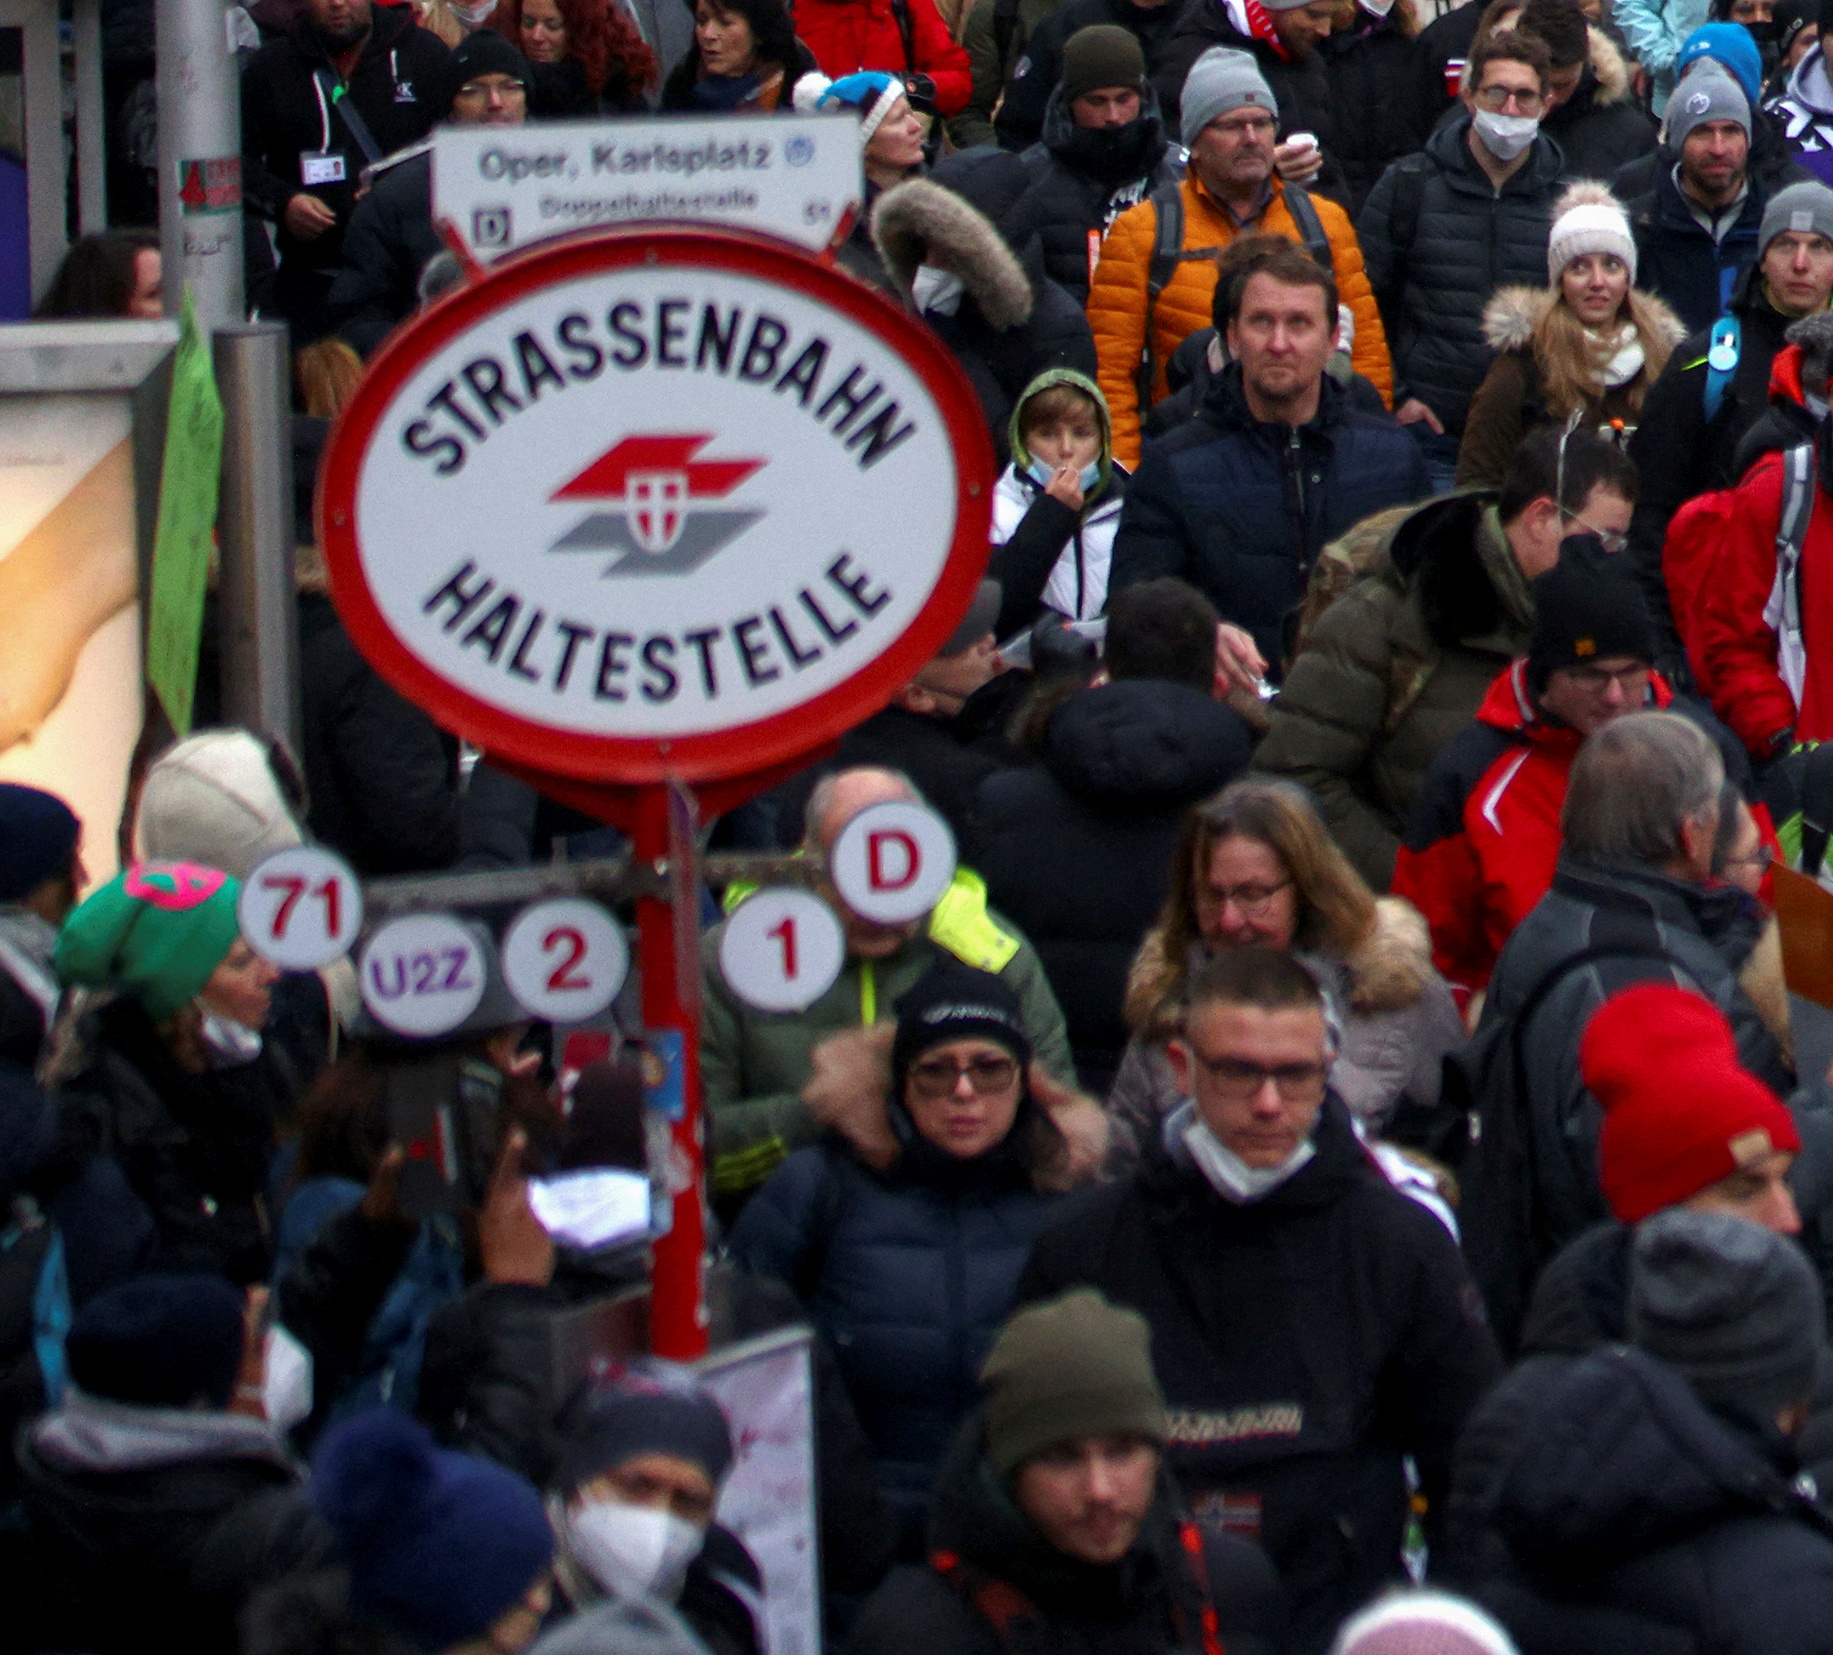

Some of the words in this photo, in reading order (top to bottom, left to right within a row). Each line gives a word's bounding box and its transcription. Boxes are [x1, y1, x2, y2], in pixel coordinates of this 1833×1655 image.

[591, 139, 771, 175] Karlsplatz
[402, 299, 917, 476] STRASSENBAHN
[421, 553, 893, 702] HALTESTELLE
[867, 828, 922, 893] D
[261, 874, 345, 941] 71
[369, 946, 475, 1001] U2Z
[543, 927, 592, 991] 2
[767, 916, 799, 982] 1
